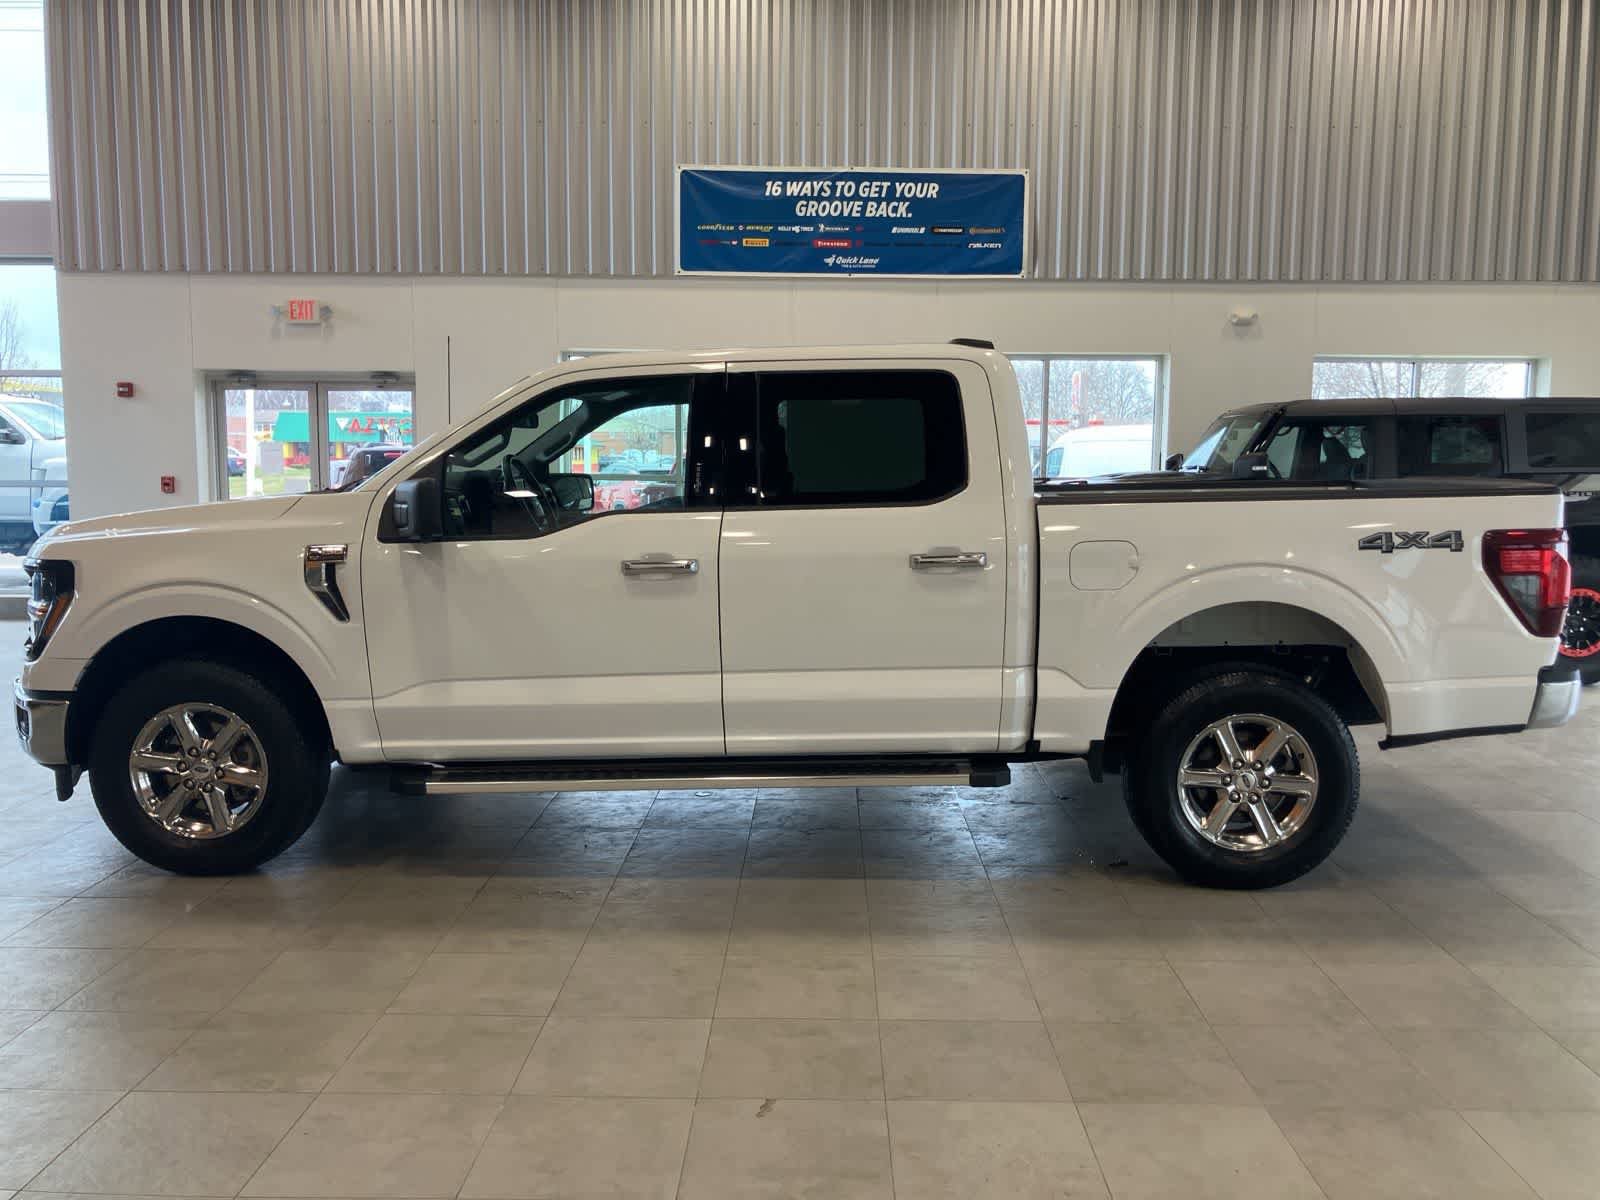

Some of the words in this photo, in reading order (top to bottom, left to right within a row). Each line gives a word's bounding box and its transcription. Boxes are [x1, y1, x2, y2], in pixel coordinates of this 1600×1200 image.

[764, 181, 782, 197] 16
[786, 181, 832, 197] WAYS
[836, 181, 855, 198] TO
[858, 182, 891, 198] GET
[895, 182, 939, 199] YOUR
[795, 200, 863, 217] GROOVE
[865, 202, 913, 218] BACK.
[836, 256, 857, 265] Quick
[858, 256, 879, 265] Lane
[289, 299, 315, 320] EXIT
